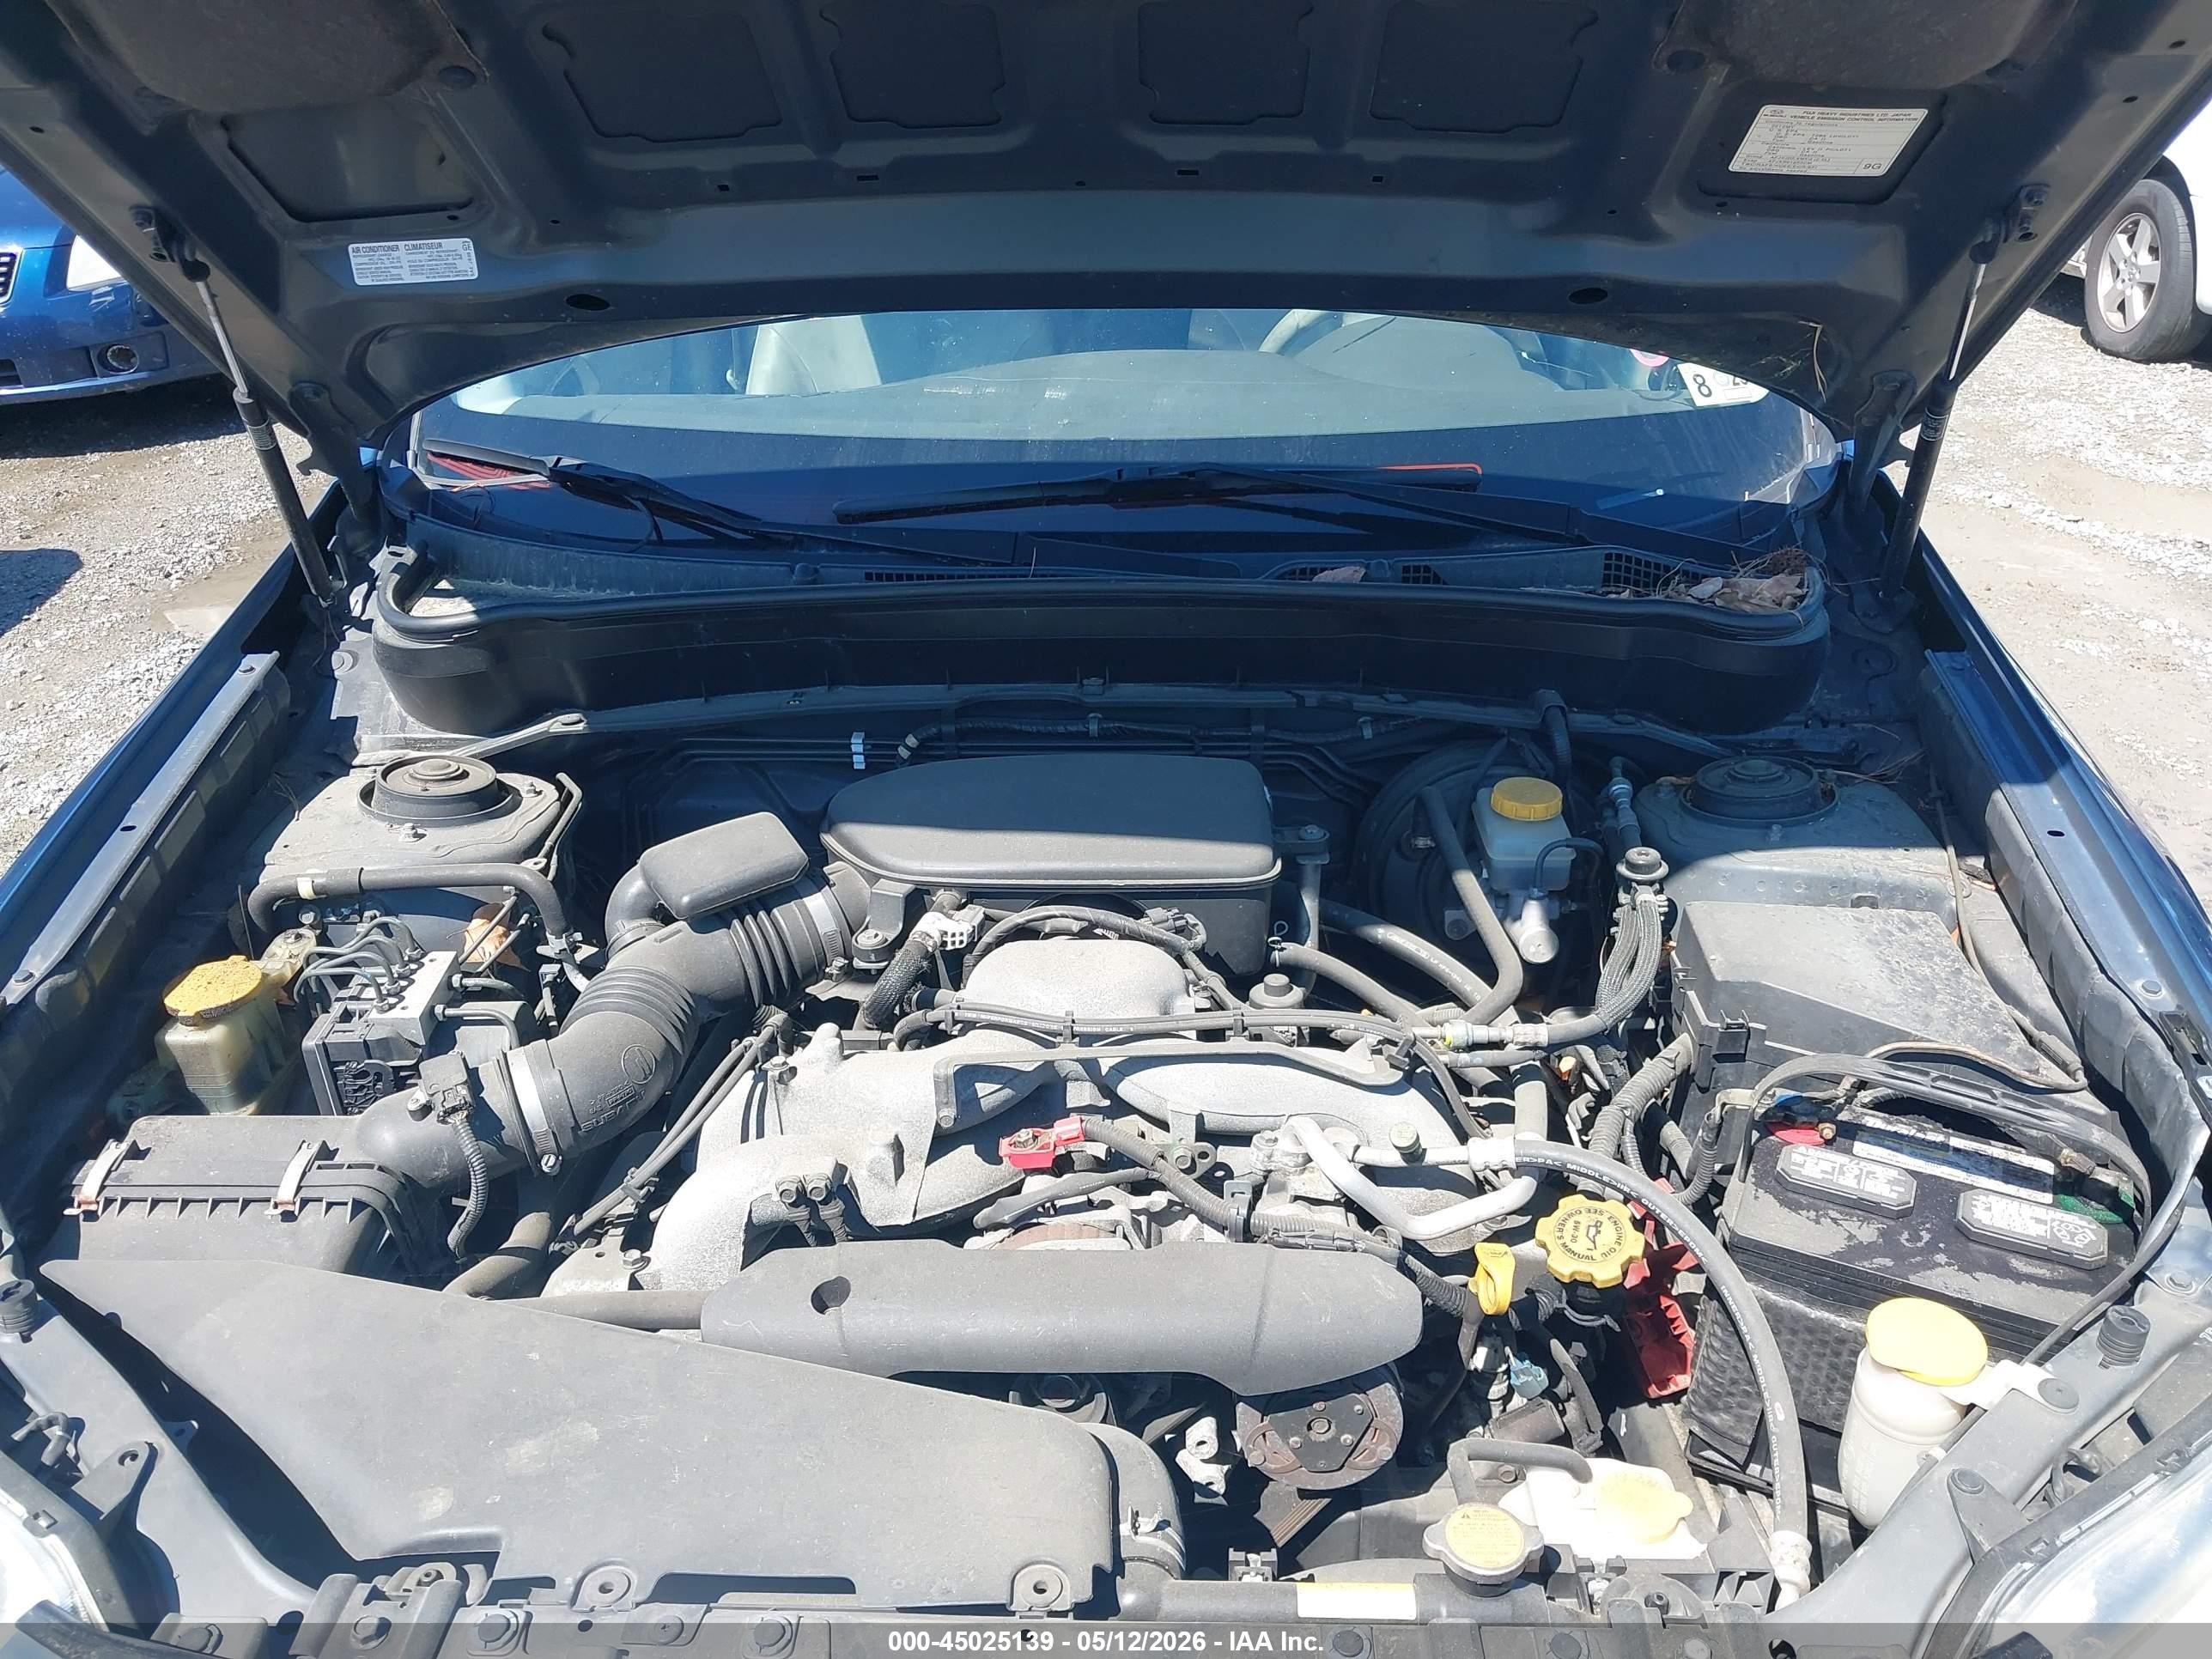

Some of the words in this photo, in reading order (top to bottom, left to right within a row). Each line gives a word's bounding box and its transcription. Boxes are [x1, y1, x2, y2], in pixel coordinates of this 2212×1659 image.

[362, 244, 399, 253] CONDITIONER
[404, 241, 443, 251] CLIMATISEUR
[1692, 374, 1712, 398] 8
[1584, 1207, 1605, 1216] SEE
[1607, 1215, 1625, 1246] ENGINE
[1559, 1242, 1597, 1261] MANUAL
[1601, 1247, 1617, 1259] OIL
